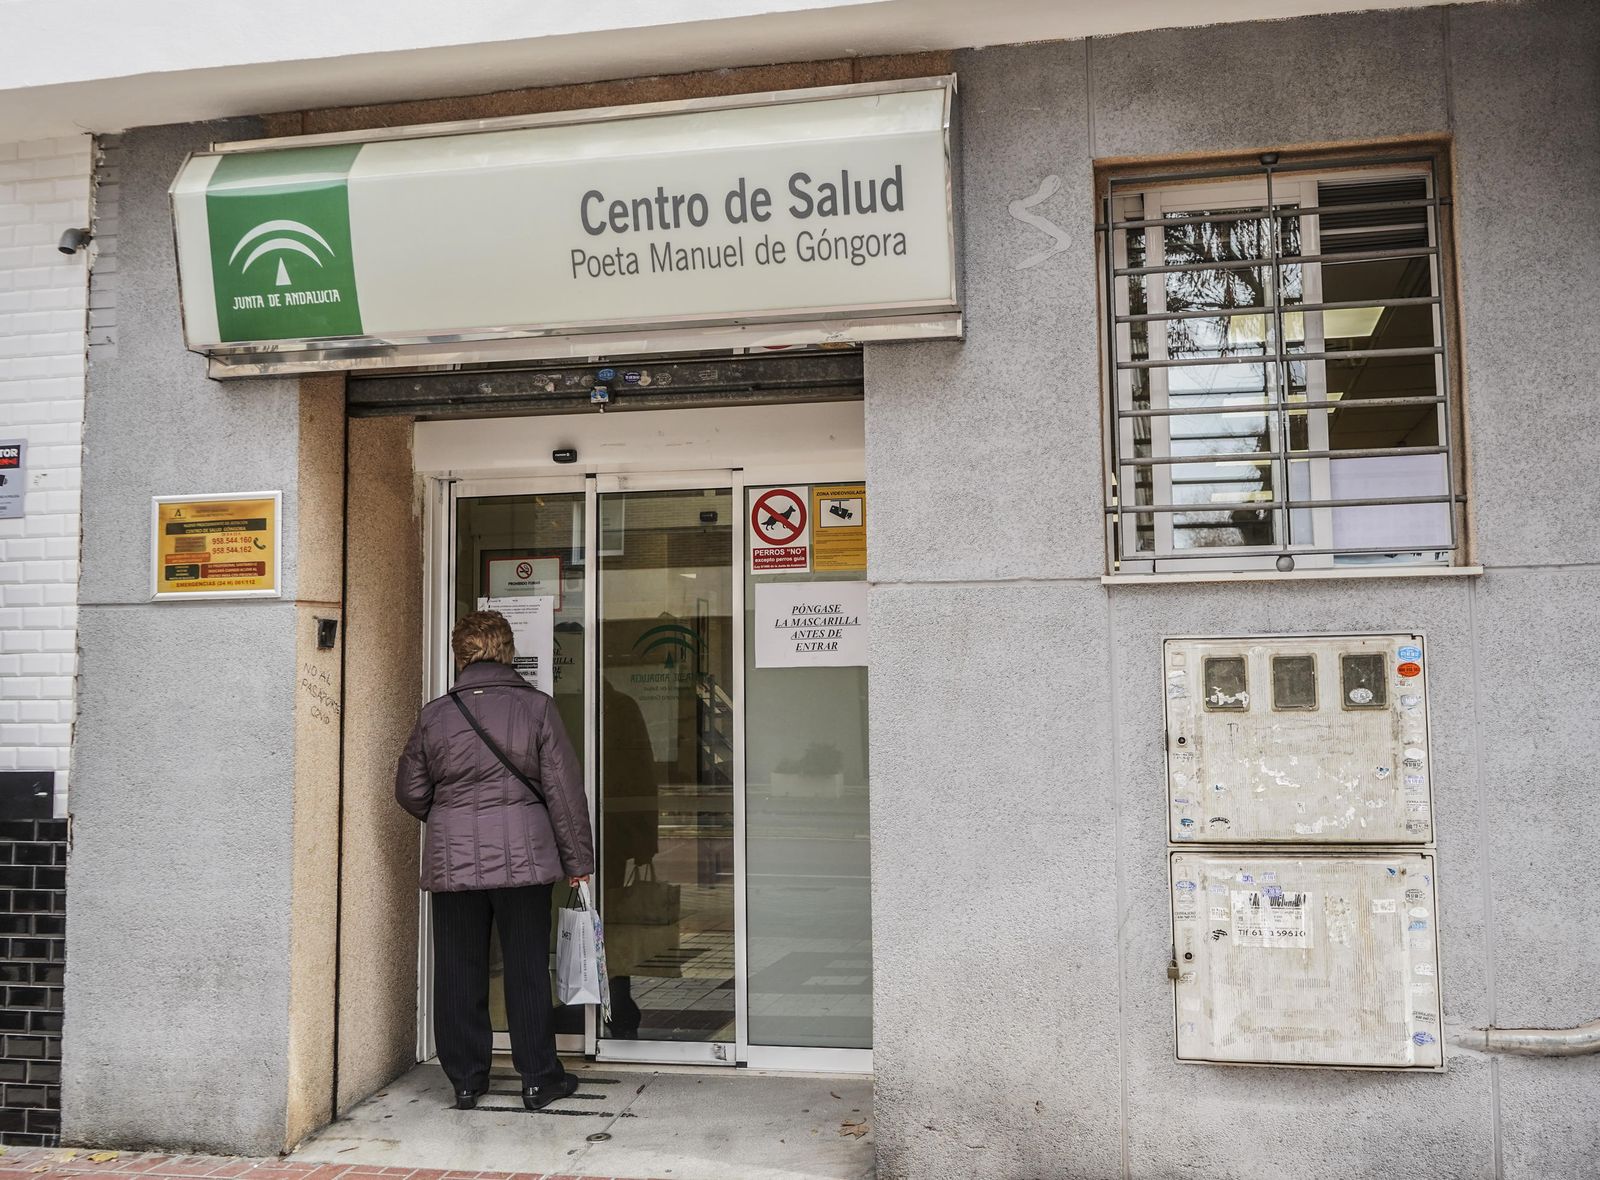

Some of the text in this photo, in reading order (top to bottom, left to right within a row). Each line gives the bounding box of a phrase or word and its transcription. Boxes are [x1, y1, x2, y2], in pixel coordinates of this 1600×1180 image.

[581, 164, 905, 236] Centro de Salud
[570, 228, 907, 279] Poeta Manuel de Góngora
[232, 294, 265, 310] JUNTA
[267, 293, 282, 308] DE
[211, 536, 252, 545] 958.544.160
[212, 546, 252, 555] 958.544.162
[754, 548, 785, 556] PERROS
[176, 580, 216, 588] EMERGENCIAS
[792, 603, 842, 615] PÓNGASE
[775, 616, 859, 628] LA MASCARILLA
[791, 628, 843, 640] ANTES DE
[796, 641, 838, 652] ENTRAR
[303, 662, 331, 686] NO AL
[1251, 929, 1306, 937] 61159610
